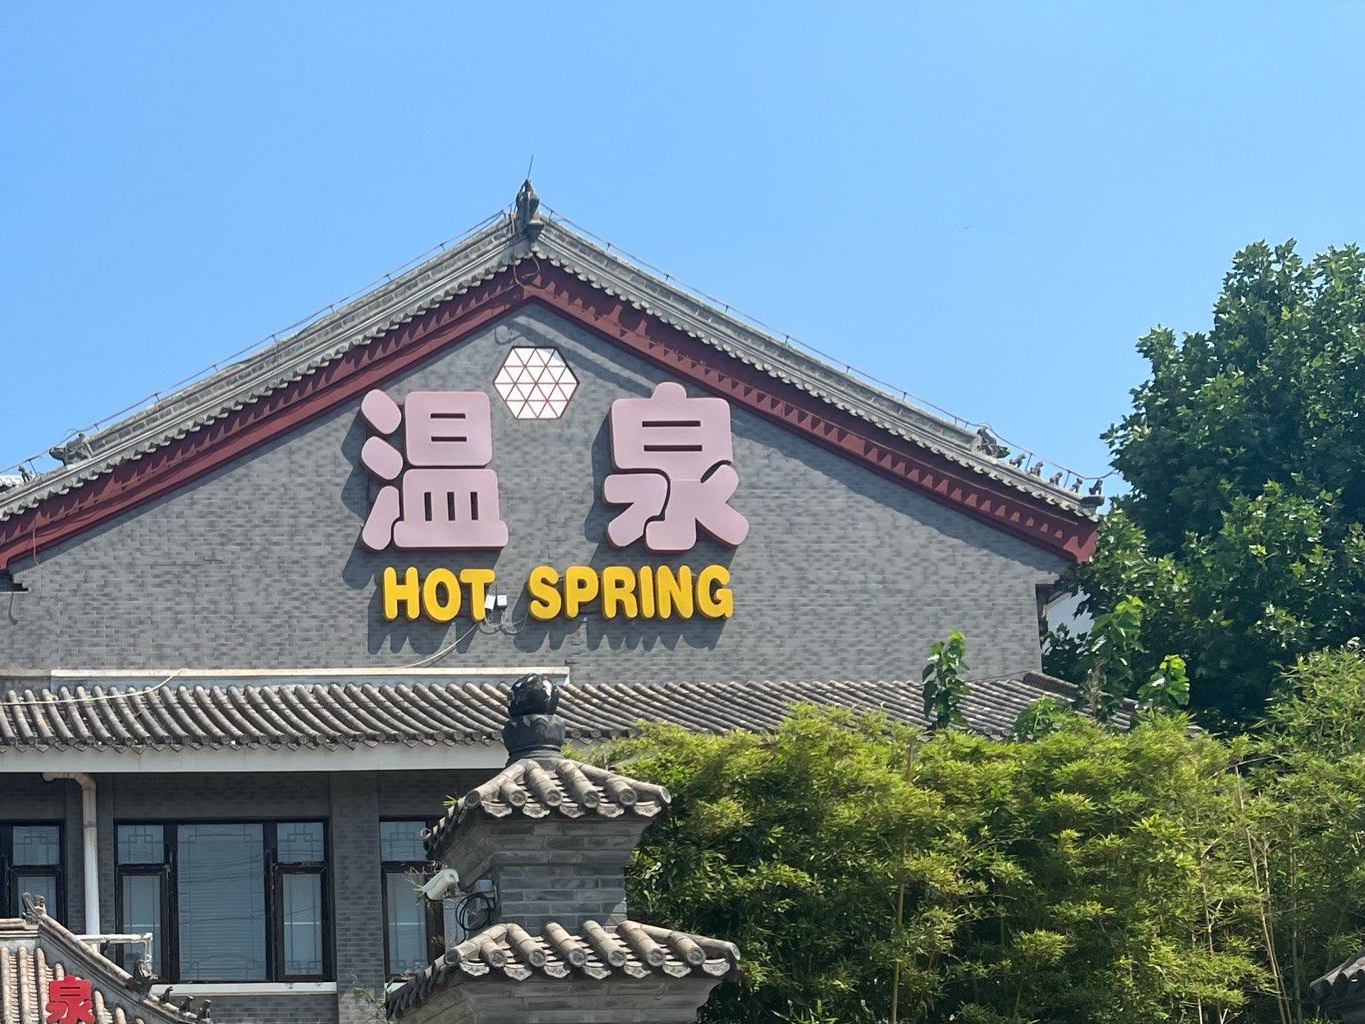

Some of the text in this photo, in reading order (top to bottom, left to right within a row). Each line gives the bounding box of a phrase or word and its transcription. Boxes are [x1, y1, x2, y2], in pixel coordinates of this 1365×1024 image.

[360, 381, 750, 553] 温泉
[382, 564, 734, 623] HOT SPRING
